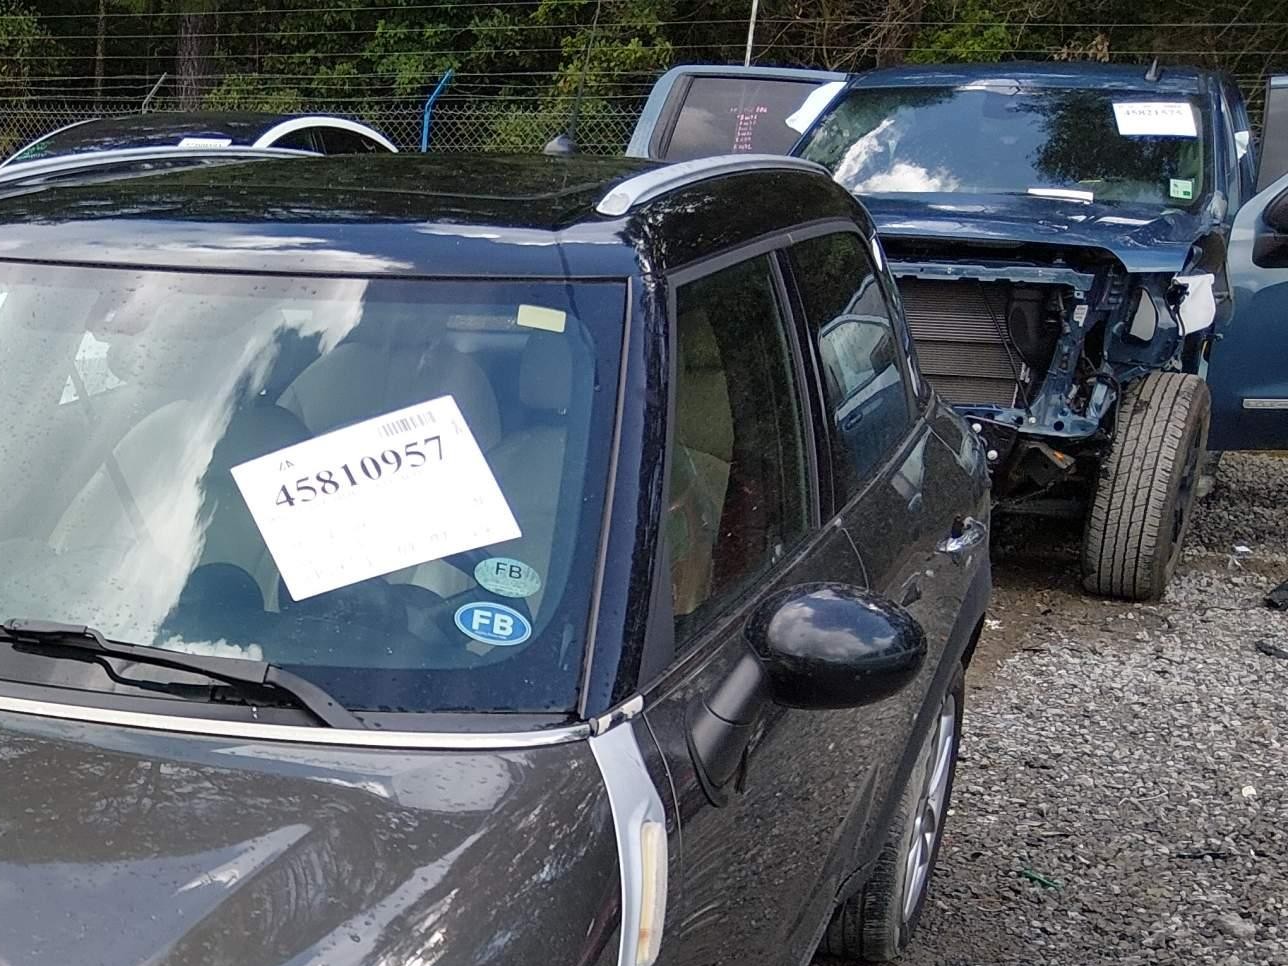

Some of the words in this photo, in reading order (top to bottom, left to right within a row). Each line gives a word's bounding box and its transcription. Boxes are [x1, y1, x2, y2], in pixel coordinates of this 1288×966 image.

[274, 434, 444, 508] 45810957
[495, 561, 522, 579] FB
[471, 608, 515, 637] FB
